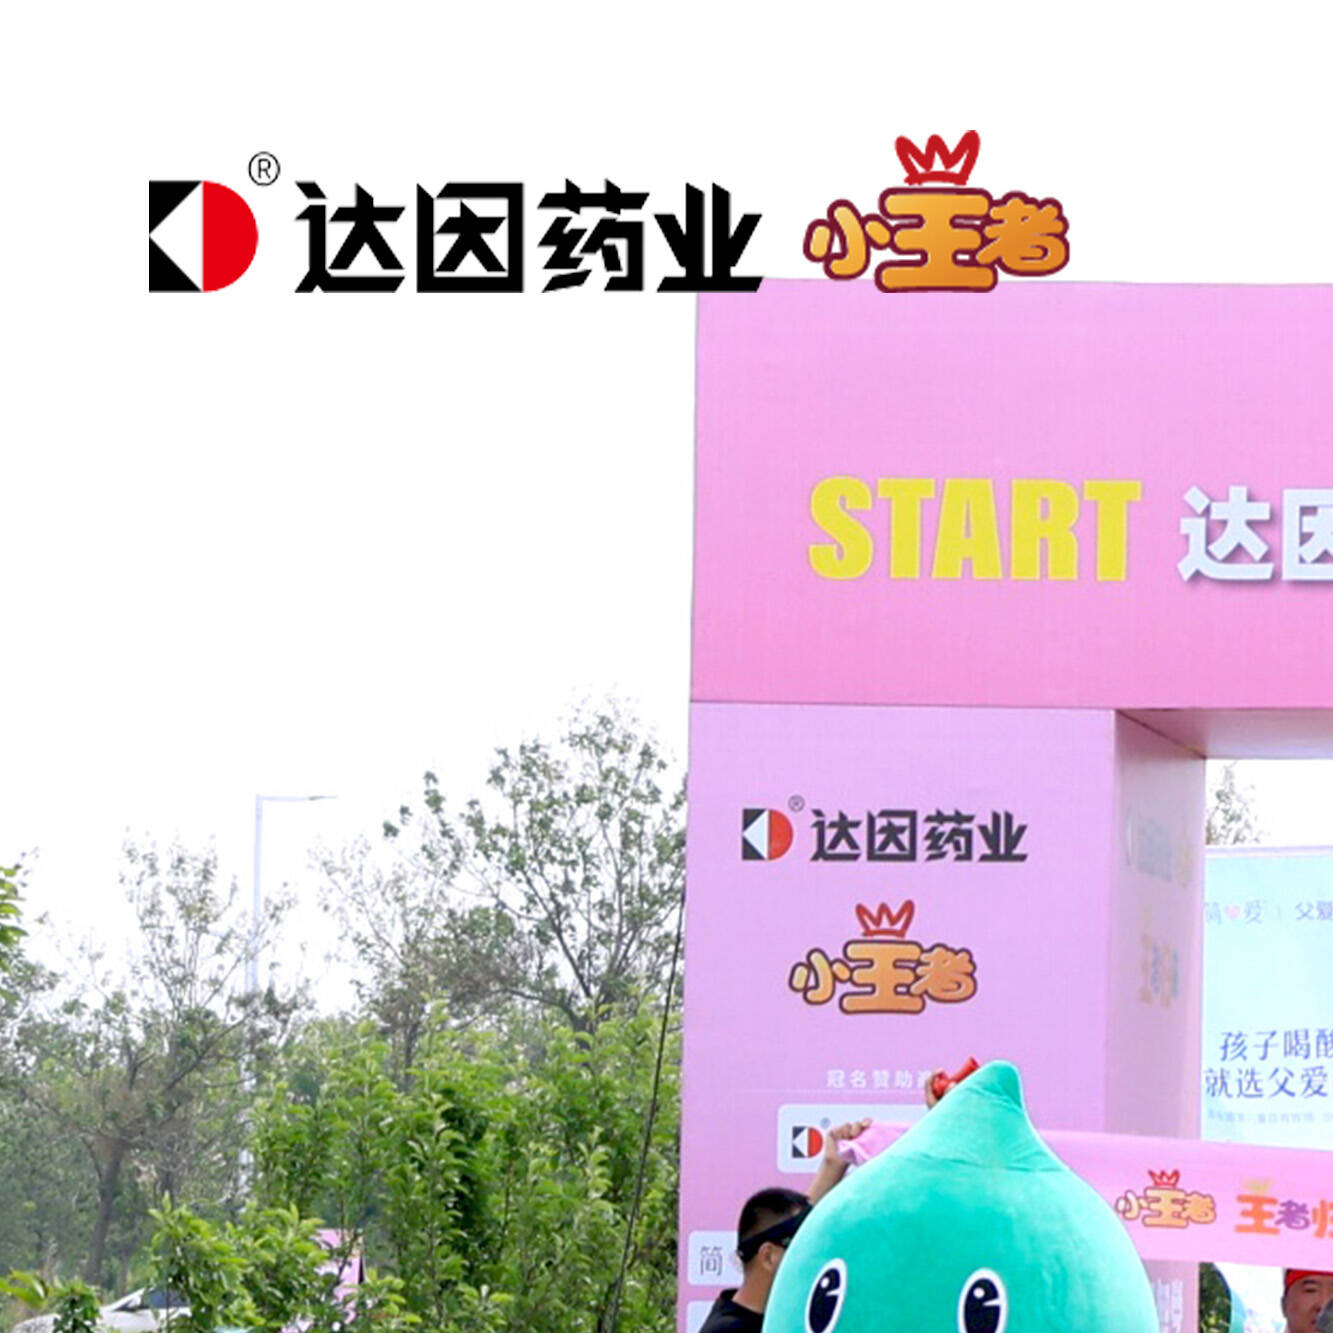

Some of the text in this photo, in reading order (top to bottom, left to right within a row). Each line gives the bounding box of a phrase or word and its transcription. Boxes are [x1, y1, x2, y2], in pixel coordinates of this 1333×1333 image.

[808, 475, 1142, 583] START
[810, 809, 1028, 863] 达因药业
[789, 939, 977, 1014] 小王者
[1115, 1189, 1216, 1229] 小王者
